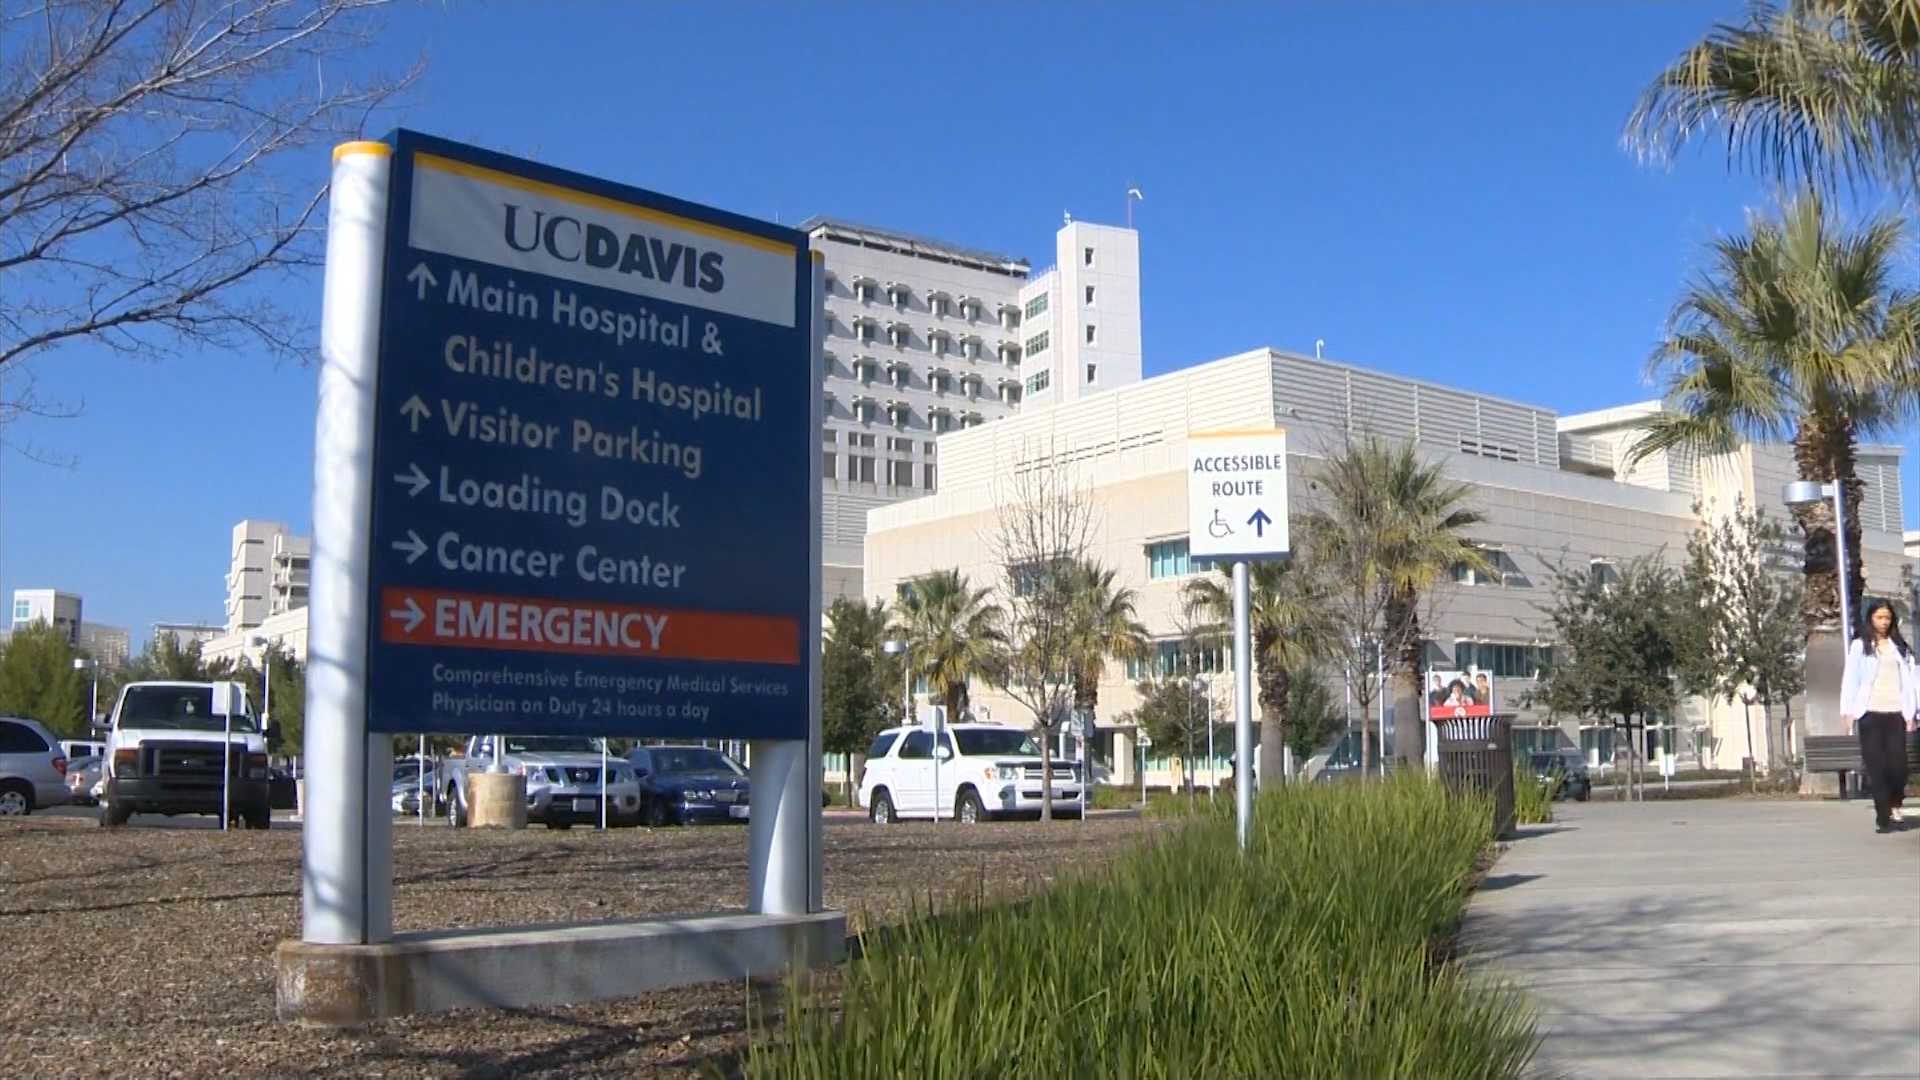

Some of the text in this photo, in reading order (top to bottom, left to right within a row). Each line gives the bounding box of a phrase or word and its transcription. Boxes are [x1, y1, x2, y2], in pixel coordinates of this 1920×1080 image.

[447, 269, 724, 355] Main Hospital &
[445, 335, 763, 422] Children's Hospital
[441, 399, 702, 480] Visitor Parking
[1194, 454, 1281, 472] ACCESSIBLE
[439, 466, 681, 530] Loading Dock
[1212, 480, 1263, 496] ROUTE
[436, 531, 687, 589] Cancer Center
[435, 597, 669, 650] EMERGENCY
[431, 662, 790, 697] Comprehensive Emergency Medical Services
[431, 693, 710, 721] Physician on Duty 24 hours a day
